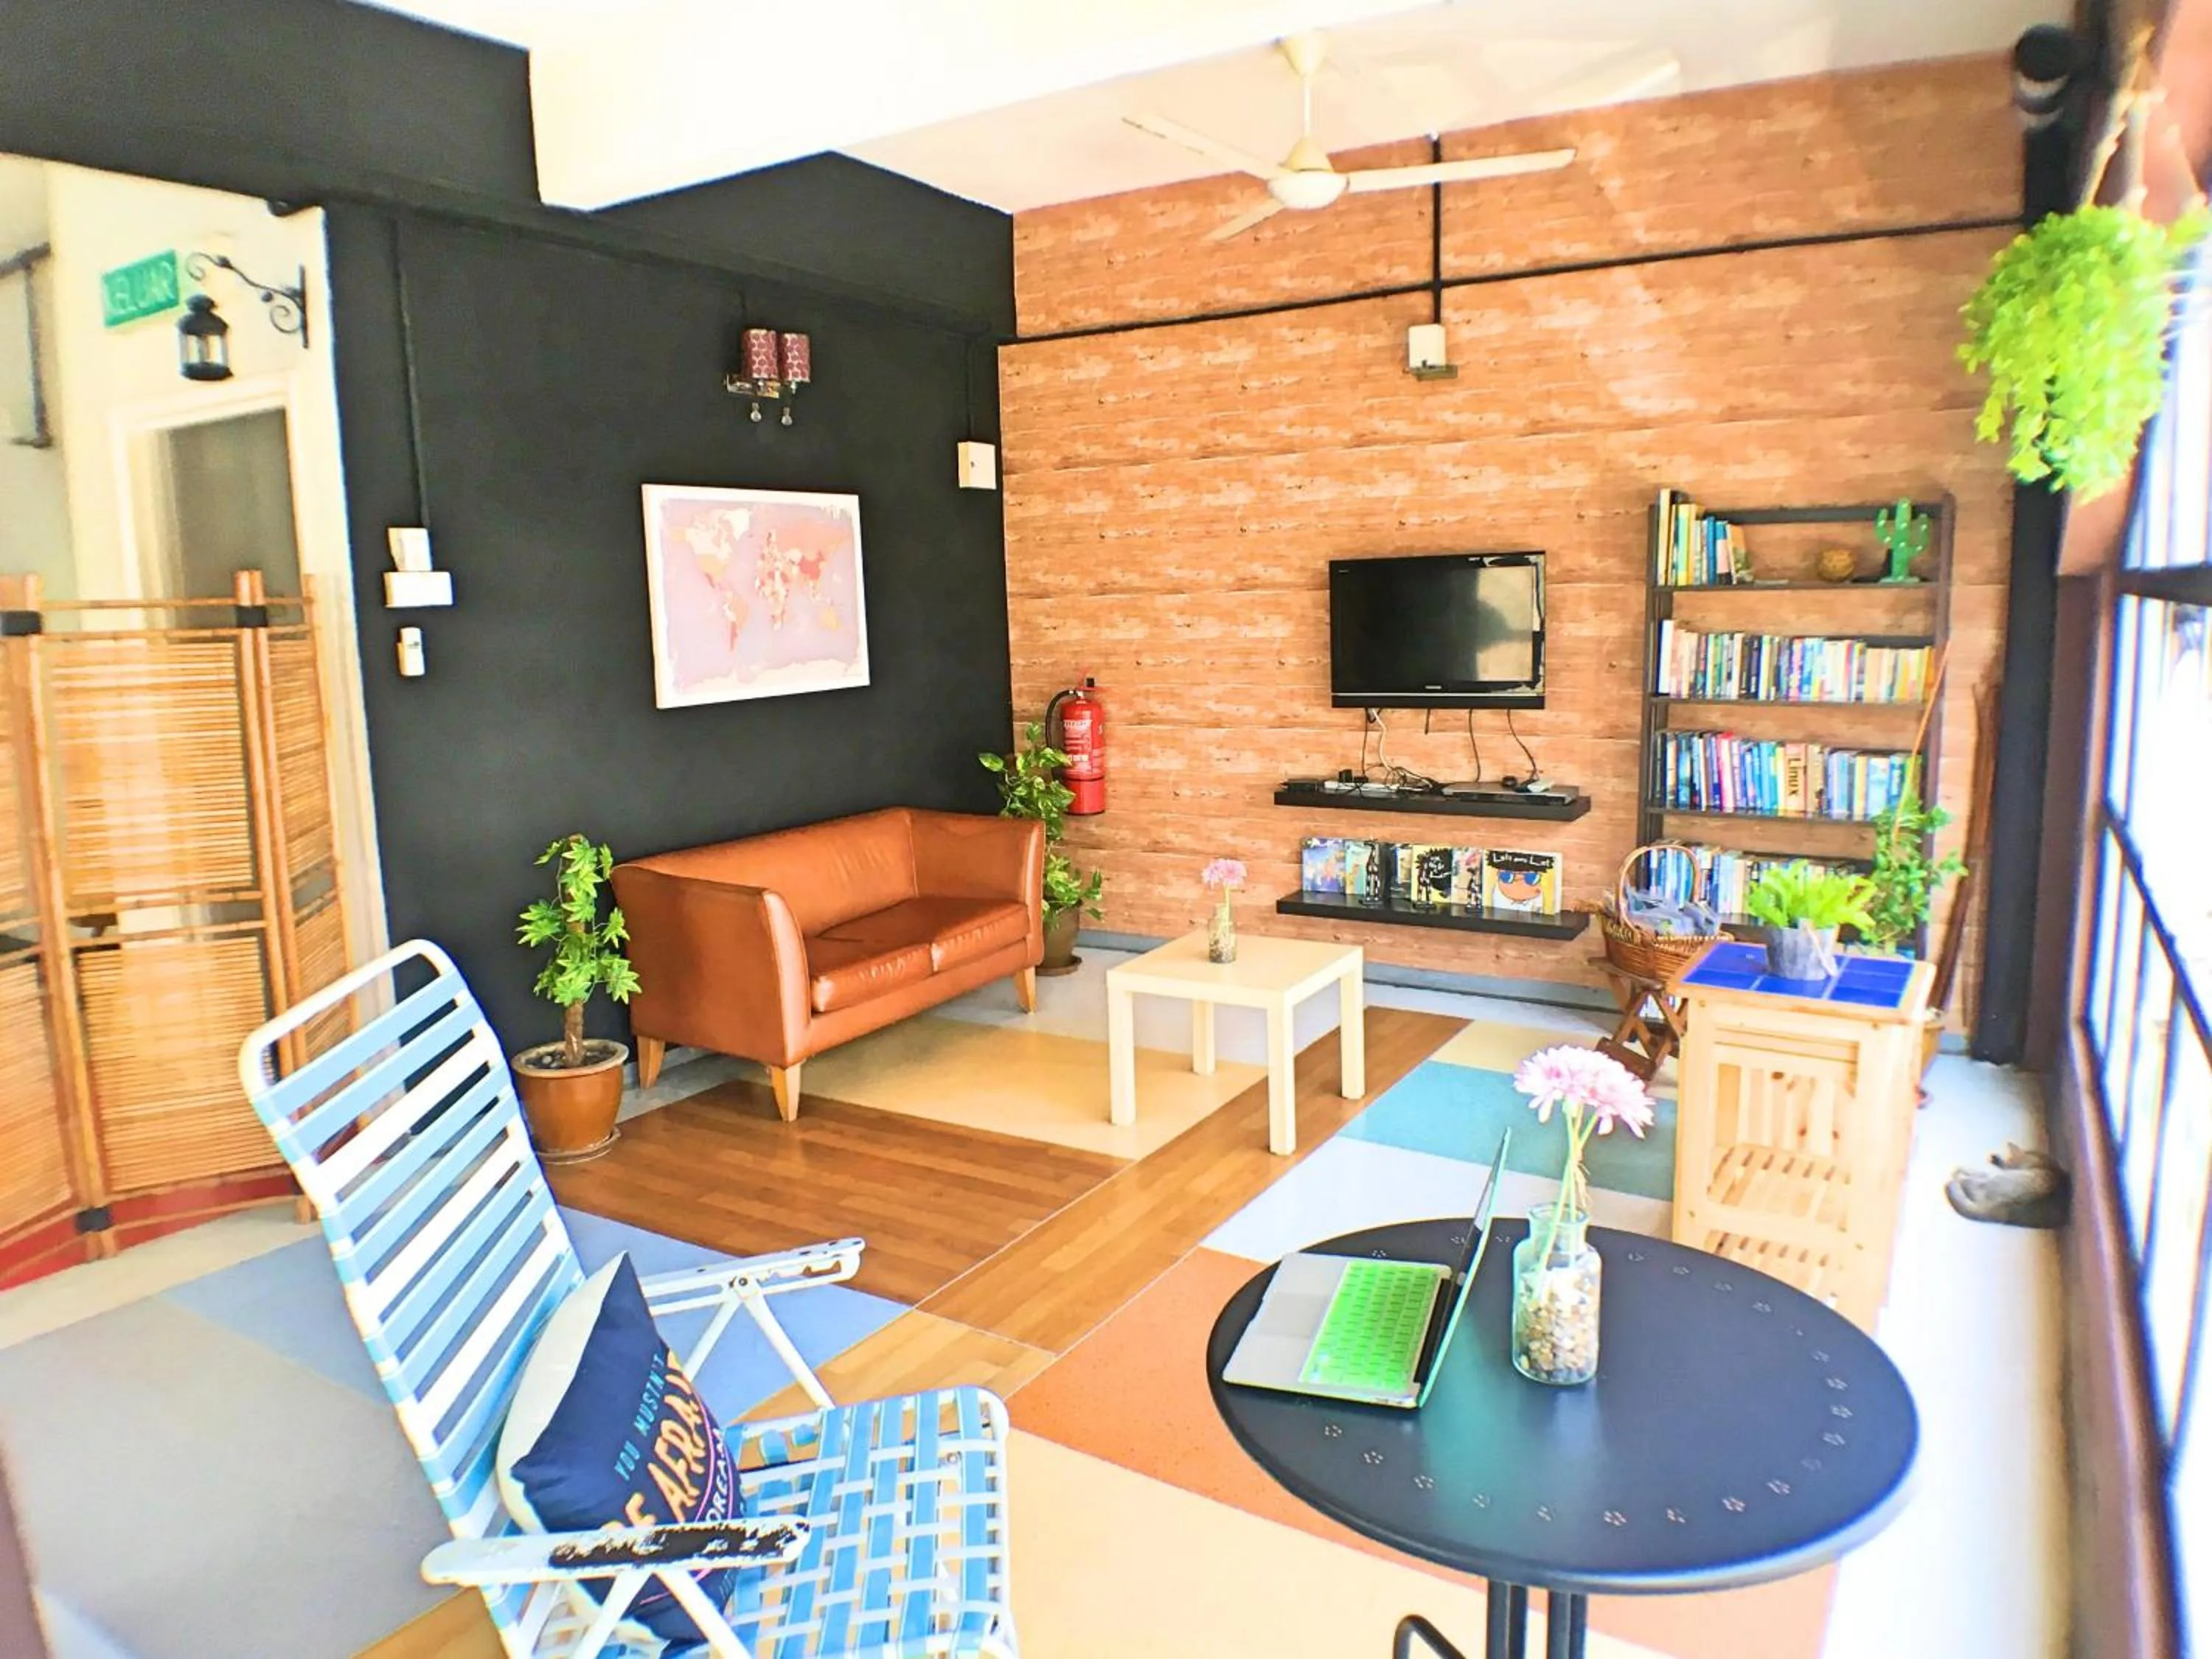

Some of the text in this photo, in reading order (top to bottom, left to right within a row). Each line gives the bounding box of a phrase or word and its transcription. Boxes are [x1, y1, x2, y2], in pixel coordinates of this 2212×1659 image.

[1787, 757, 1802, 796] Linux
[614, 1354, 665, 1481] YOU MUSTN'T
